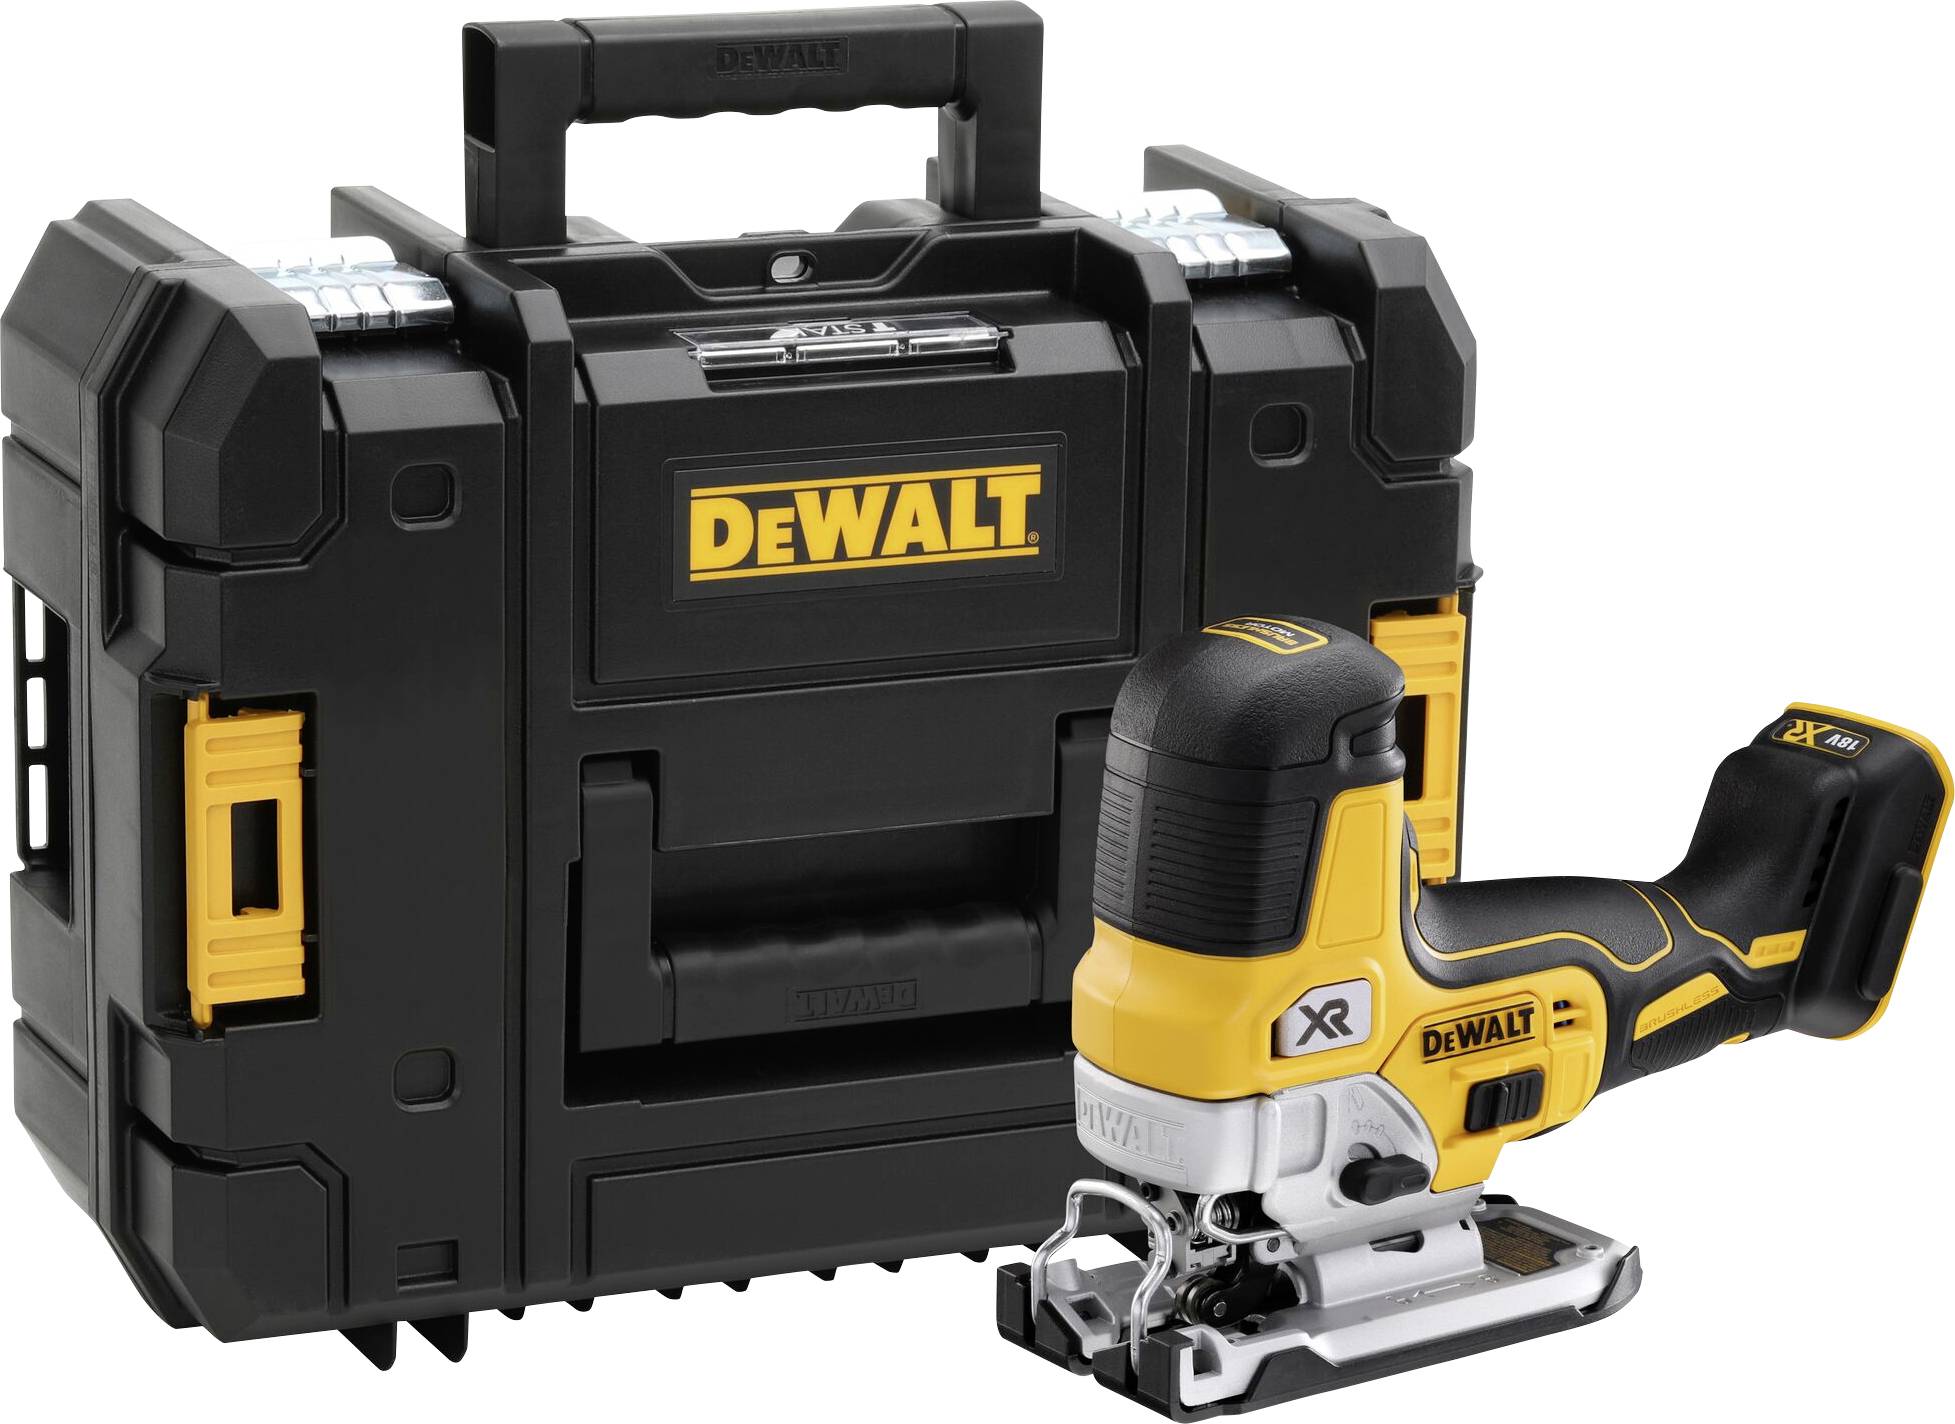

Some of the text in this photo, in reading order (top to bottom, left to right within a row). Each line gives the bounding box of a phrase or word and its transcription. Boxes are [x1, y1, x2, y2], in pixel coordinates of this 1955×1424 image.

[1783, 719, 1860, 751] XR 18V
[1296, 997, 1353, 1047] XR
[1422, 1007, 1535, 1058] DEWALT
[1639, 985, 1721, 1033] BRUSHLESS
